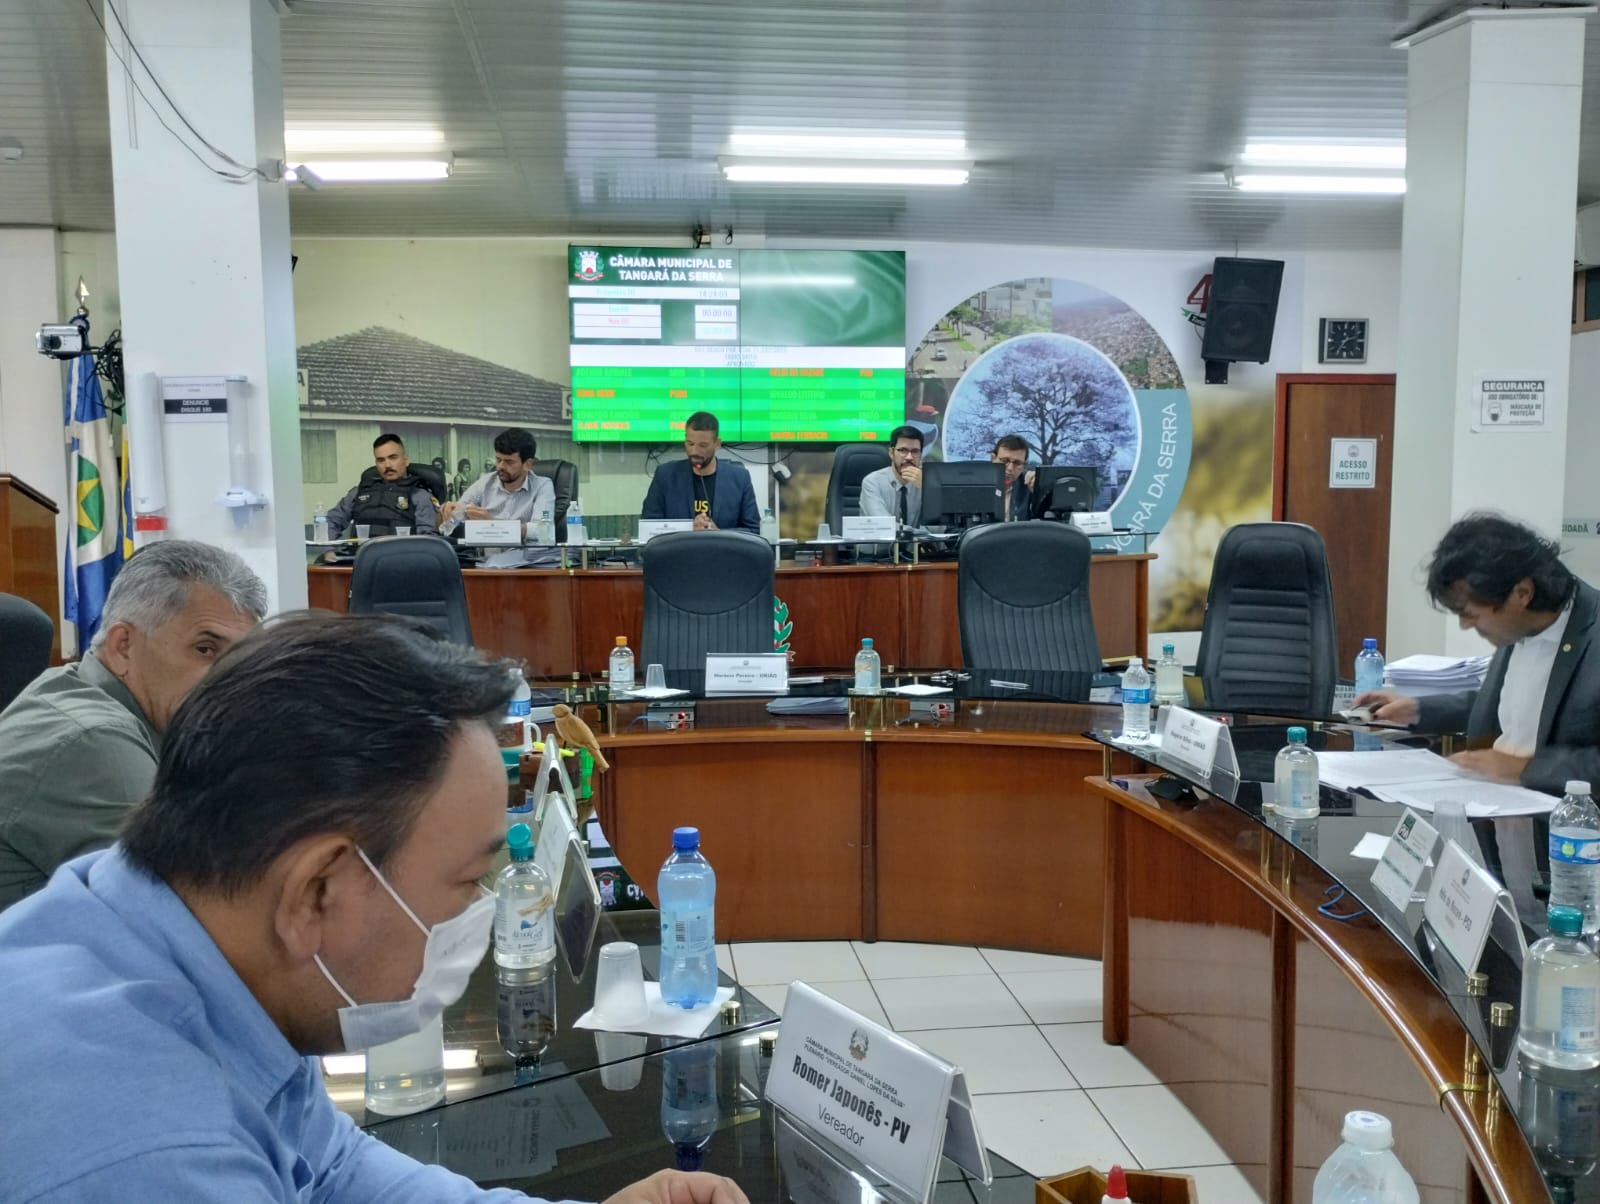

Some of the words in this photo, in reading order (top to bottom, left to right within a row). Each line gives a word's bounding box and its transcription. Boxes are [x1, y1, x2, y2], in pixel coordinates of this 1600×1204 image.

[609, 254, 656, 268] CÂMARA
[657, 258, 716, 268] MUNICIPAL
[718, 258, 732, 268] DE
[619, 269, 670, 281] TANGARÁ
[672, 271, 687, 281] DA
[688, 271, 724, 282] SERRA
[1483, 382, 1543, 392] SEGURANÇA
[1157, 402, 1177, 469] SERRA
[1340, 460, 1367, 468] ACESSO
[1147, 472, 1169, 498] DA
[1336, 472, 1370, 480] RESTRITO
[806, 1036, 823, 1050] CÂMARA
[824, 1046, 844, 1064] MUNICIPAL
[853, 1064, 874, 1081] TANGARÁ
[874, 1077, 881, 1085] DA
[882, 1081, 898, 1096] SERRA
[792, 1056, 831, 1093] Romer
[830, 1079, 882, 1127] Japonês
[890, 1116, 910, 1144] PV
[866, 1082, 882, 1096] LOPES
[882, 1091, 890, 1100] DA
[818, 1104, 864, 1147] Vereador
